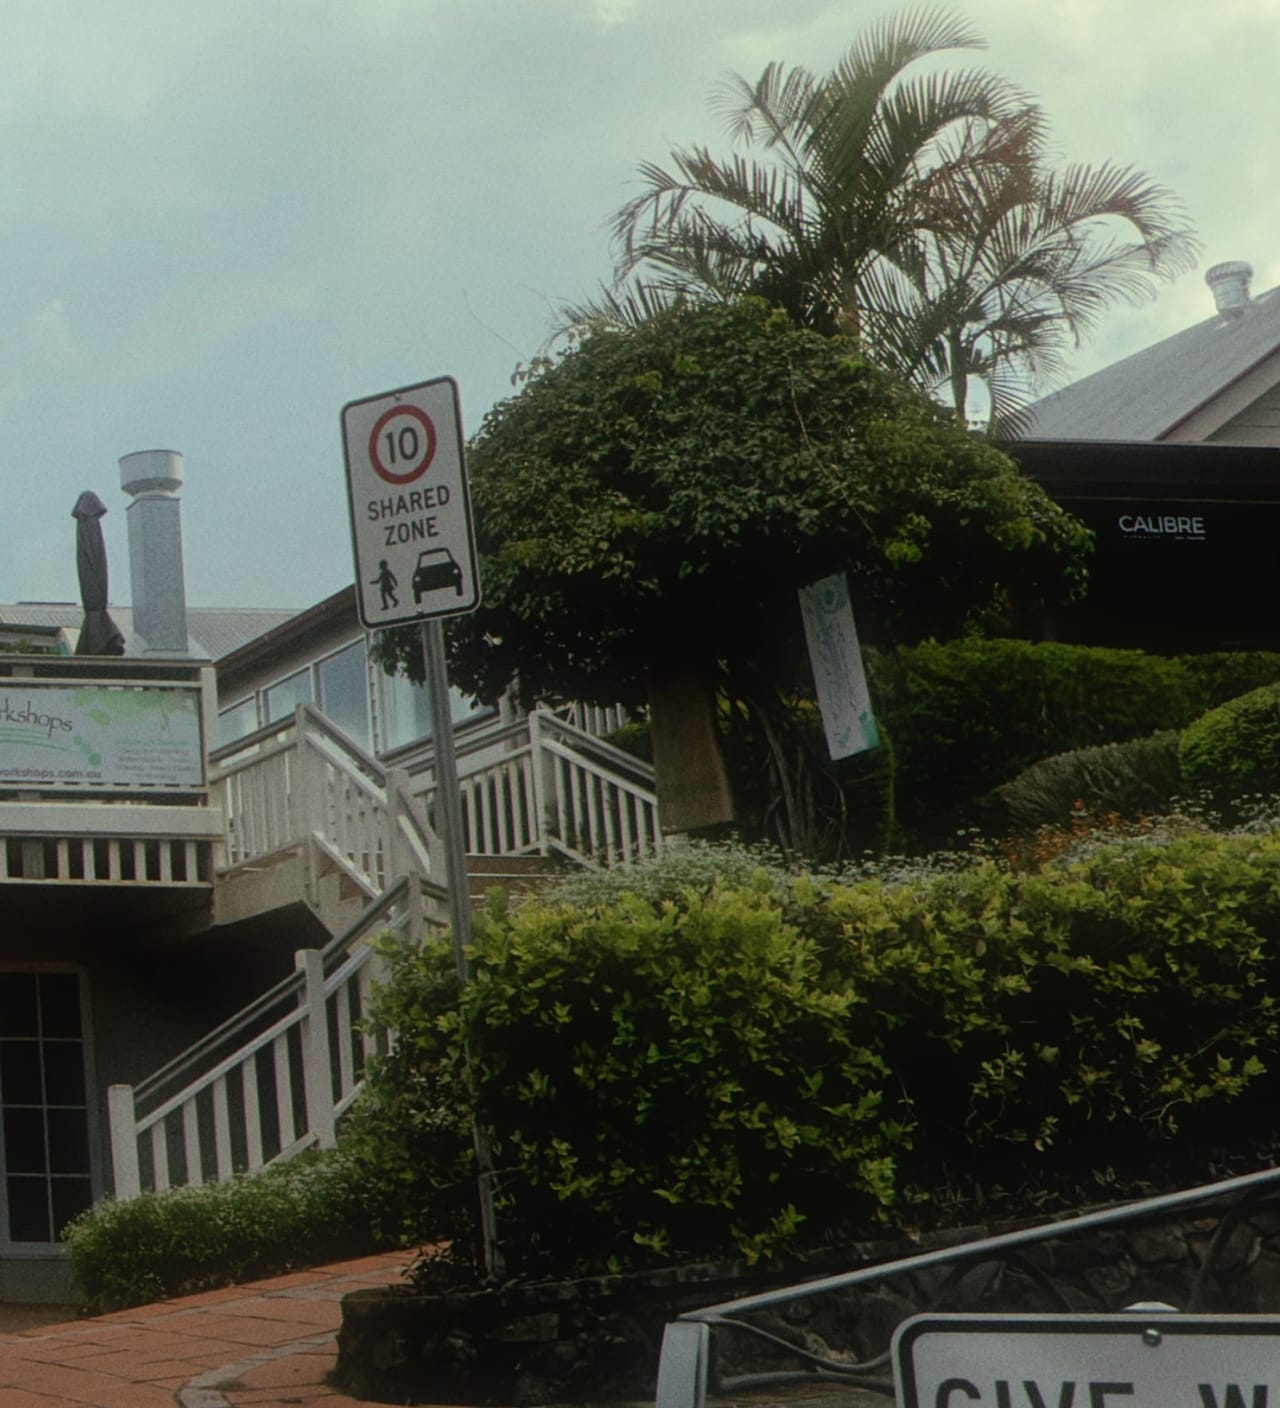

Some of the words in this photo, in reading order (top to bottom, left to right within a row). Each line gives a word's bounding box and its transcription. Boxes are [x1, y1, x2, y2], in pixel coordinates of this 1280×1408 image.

[385, 426, 418, 464] 10
[367, 485, 450, 521] SHARED
[384, 516, 440, 546] ZONE
[1118, 515, 1206, 534] CALIBRE
